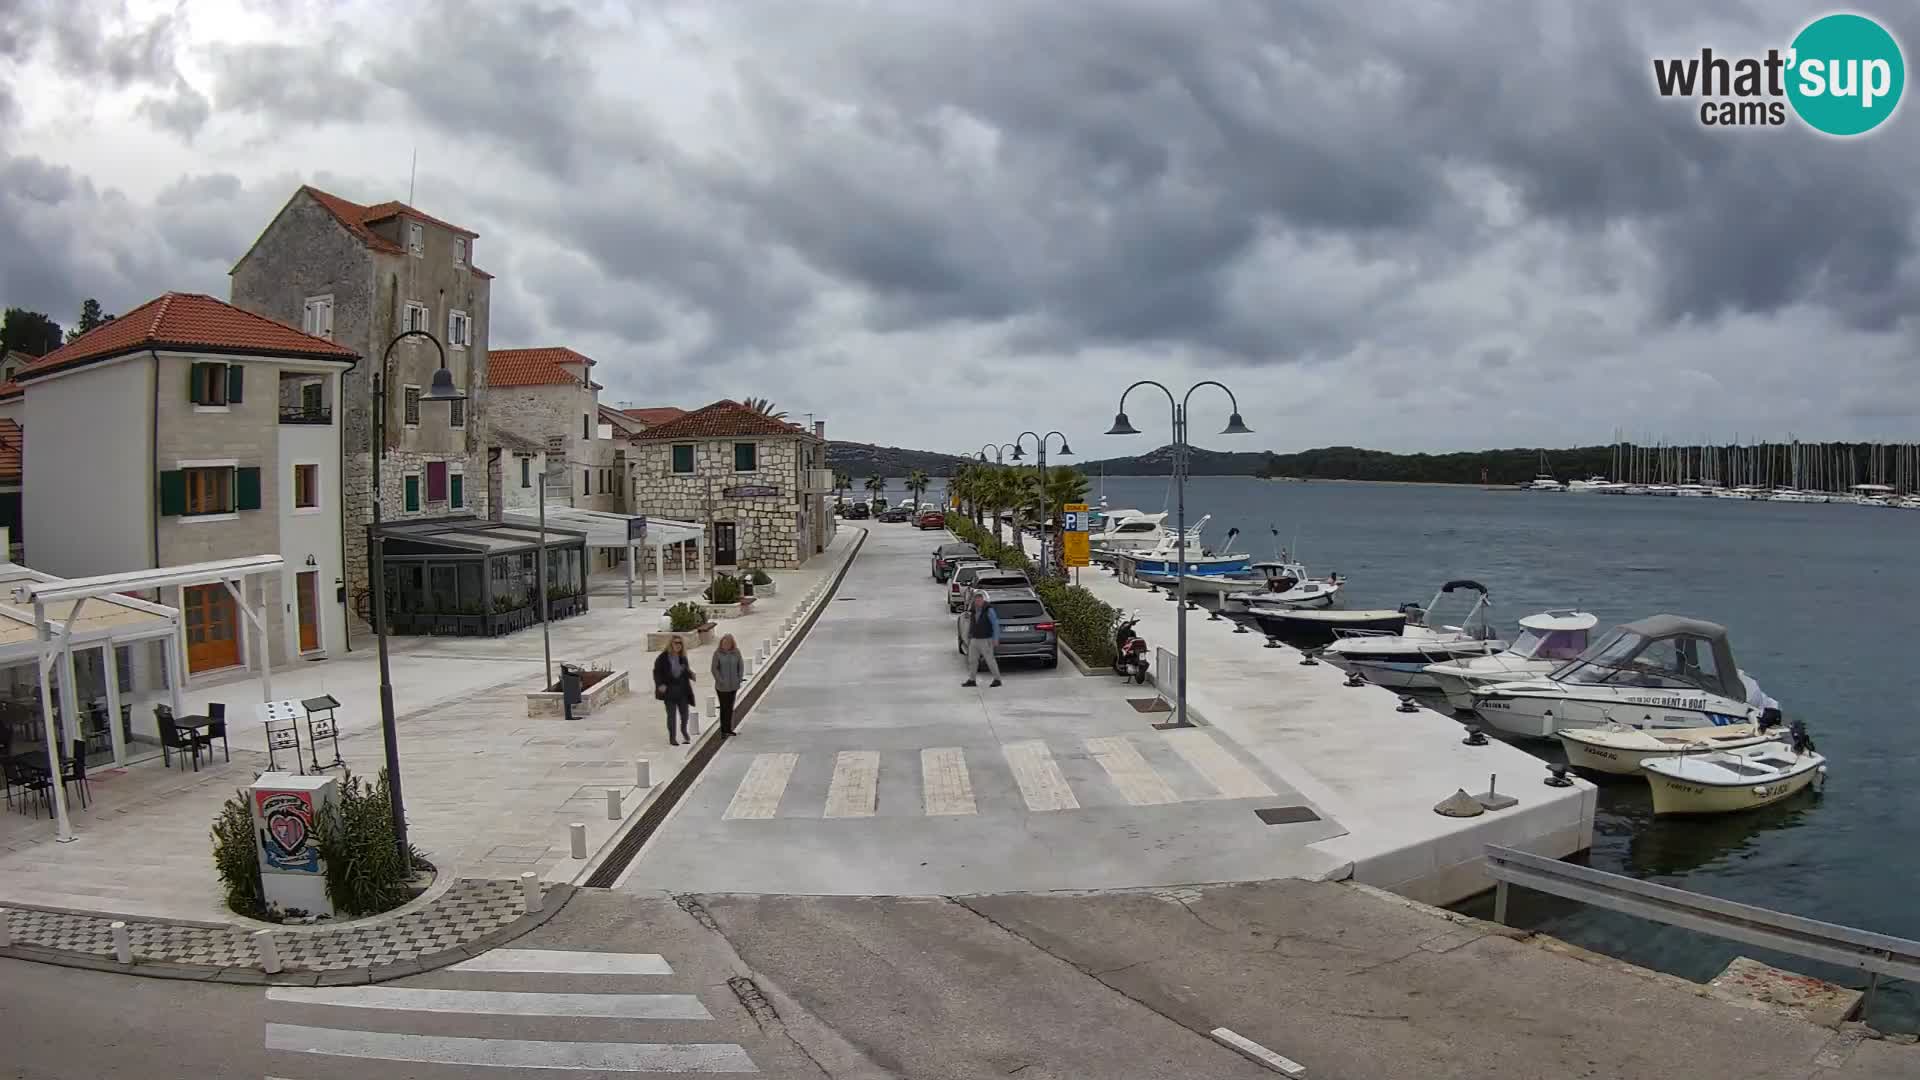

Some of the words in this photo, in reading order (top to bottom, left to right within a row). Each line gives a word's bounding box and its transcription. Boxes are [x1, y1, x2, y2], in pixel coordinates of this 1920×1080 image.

[1065, 513, 1076, 530] P
[1661, 697, 1681, 706] RENT
[1682, 698, 1687, 707] A
[1688, 698, 1706, 709] BOAT
